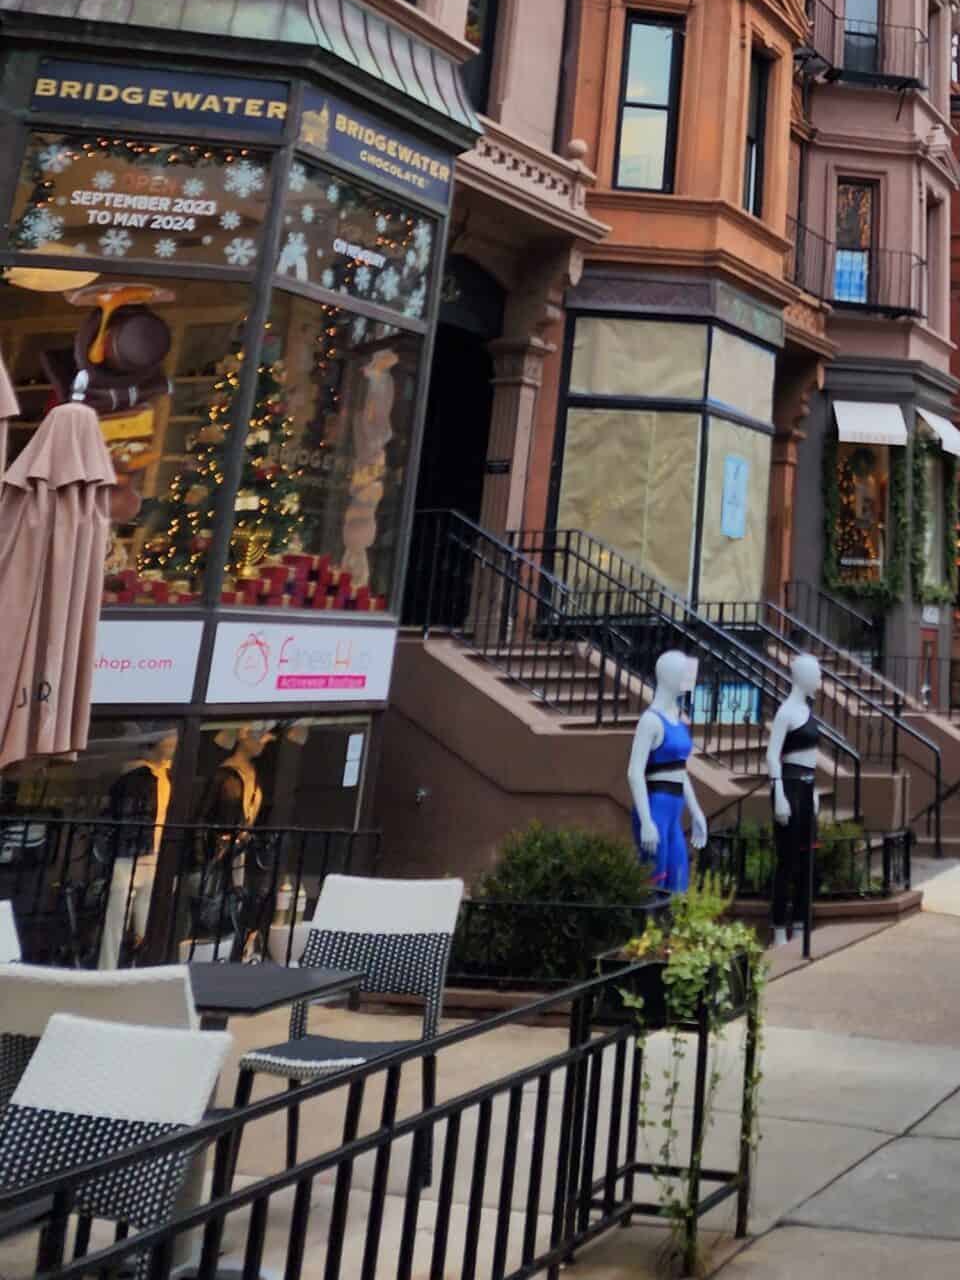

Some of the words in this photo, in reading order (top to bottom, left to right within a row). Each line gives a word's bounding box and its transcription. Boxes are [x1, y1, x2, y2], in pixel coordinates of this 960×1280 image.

[34, 78, 288, 119] BRIDGEWATER
[335, 113, 450, 182] BRIDGEWATER
[359, 149, 426, 189] CHOCOLATE
[70, 190, 171, 211] SEPTEMBER
[172, 199, 217, 216] 2023
[87, 209, 111, 225] TO
[112, 211, 149, 228] MAY
[150, 215, 195, 232] 2024
